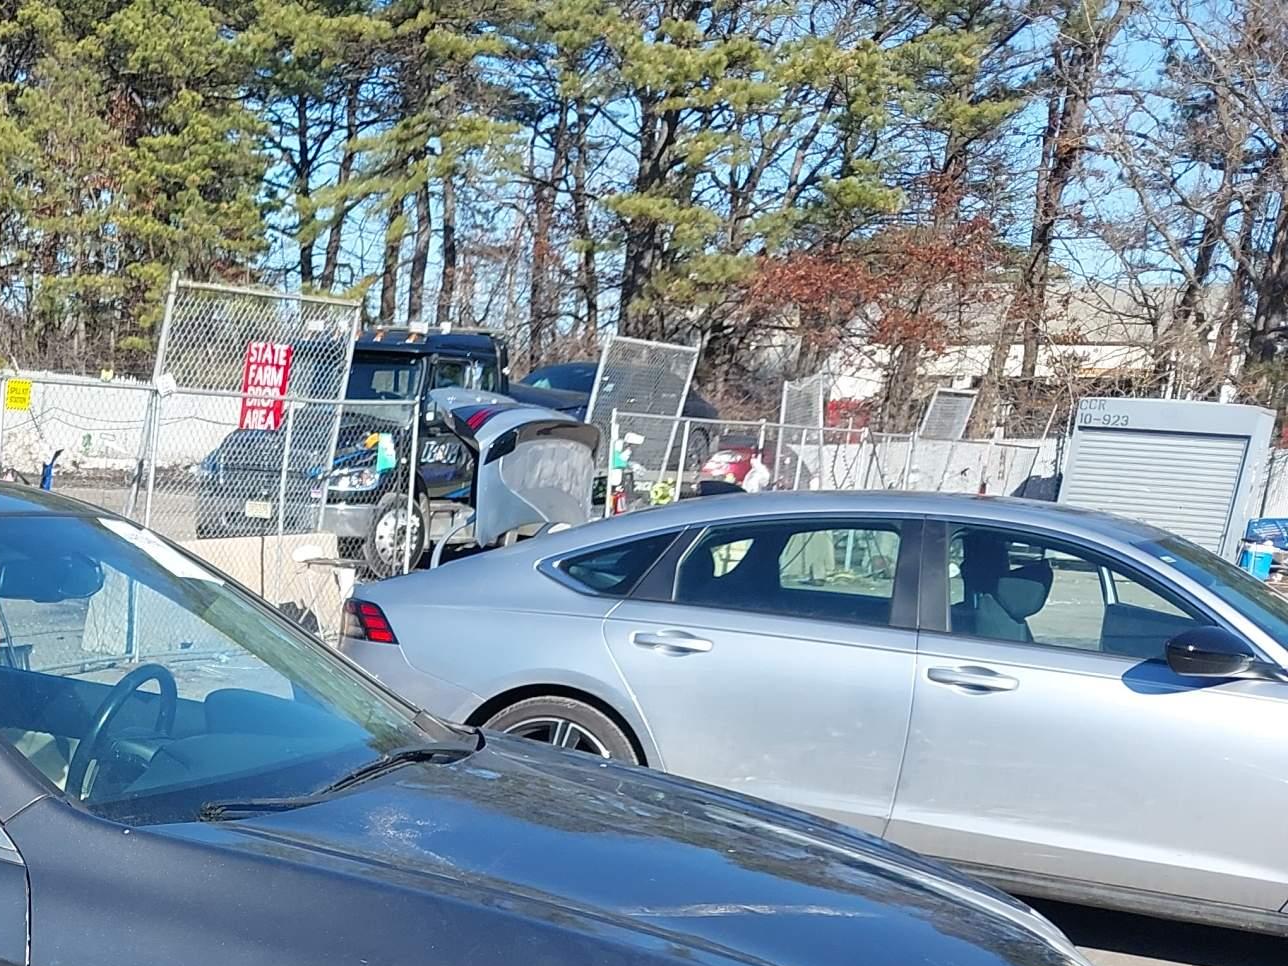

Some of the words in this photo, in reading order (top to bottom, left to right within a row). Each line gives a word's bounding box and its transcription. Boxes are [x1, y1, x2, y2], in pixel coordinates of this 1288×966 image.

[249, 342, 289, 366] STATE
[248, 364, 284, 387] FARM
[246, 386, 281, 408] DROP
[1080, 399, 1107, 410] CCR
[242, 408, 275, 430] AREA
[1079, 412, 1129, 426] 10-923
